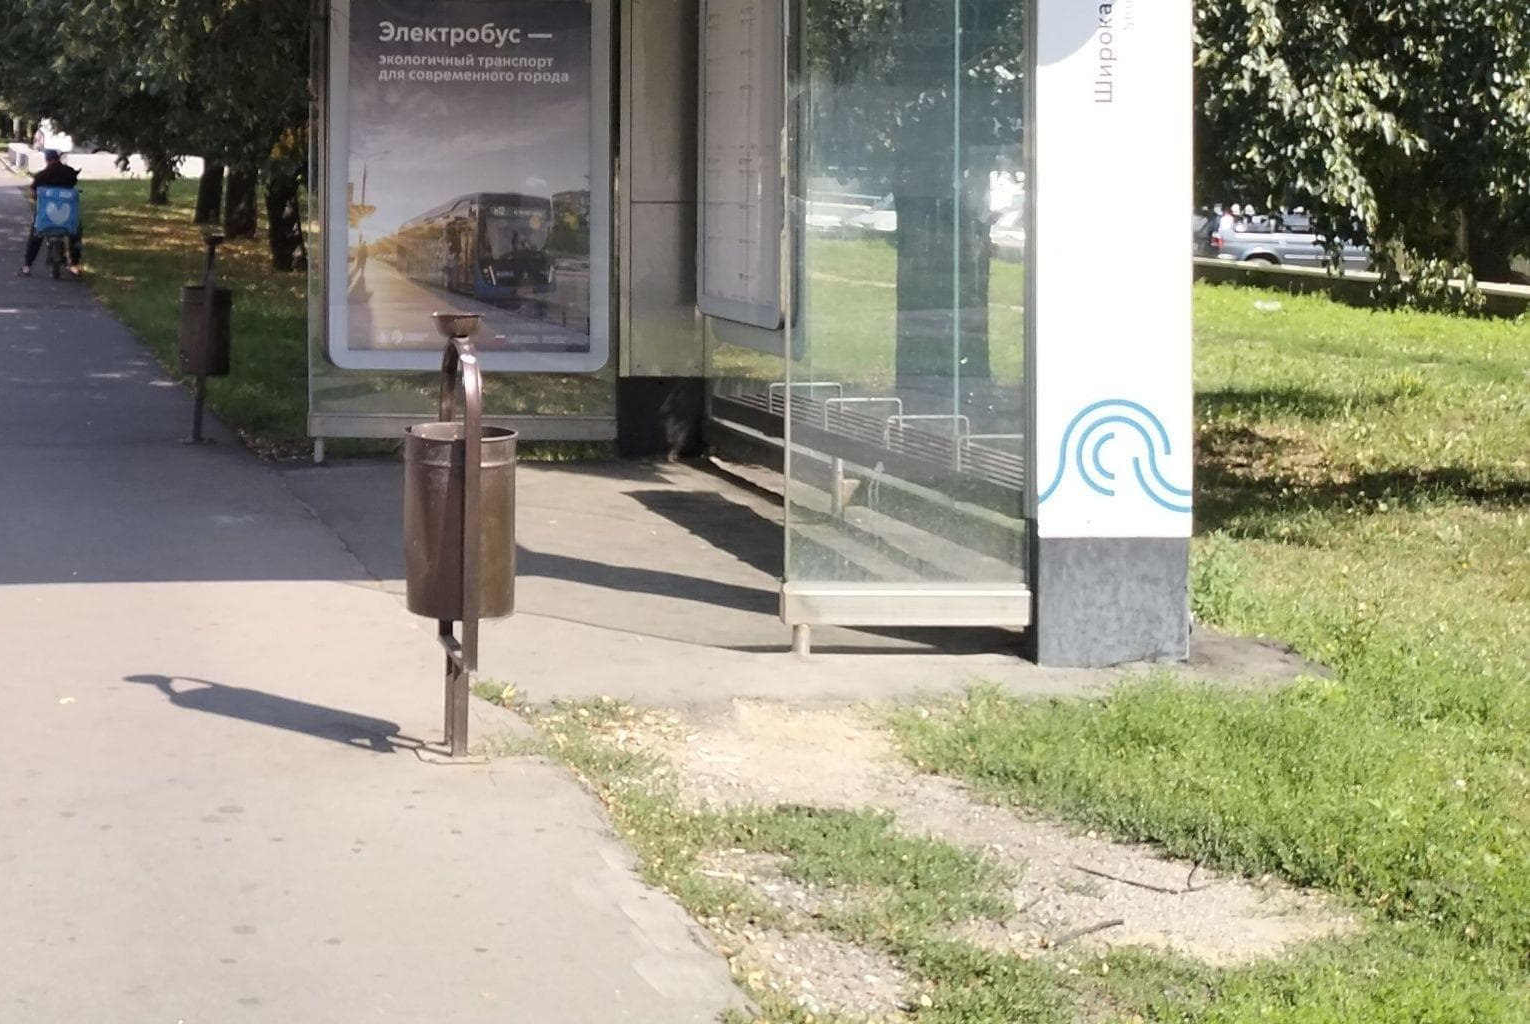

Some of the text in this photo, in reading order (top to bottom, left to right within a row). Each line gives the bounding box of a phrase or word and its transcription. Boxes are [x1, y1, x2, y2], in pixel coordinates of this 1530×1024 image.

[378, 21, 521, 48] Электробус
[378, 54, 554, 69] экологичный транспорт
[378, 70, 570, 85] для современного города
